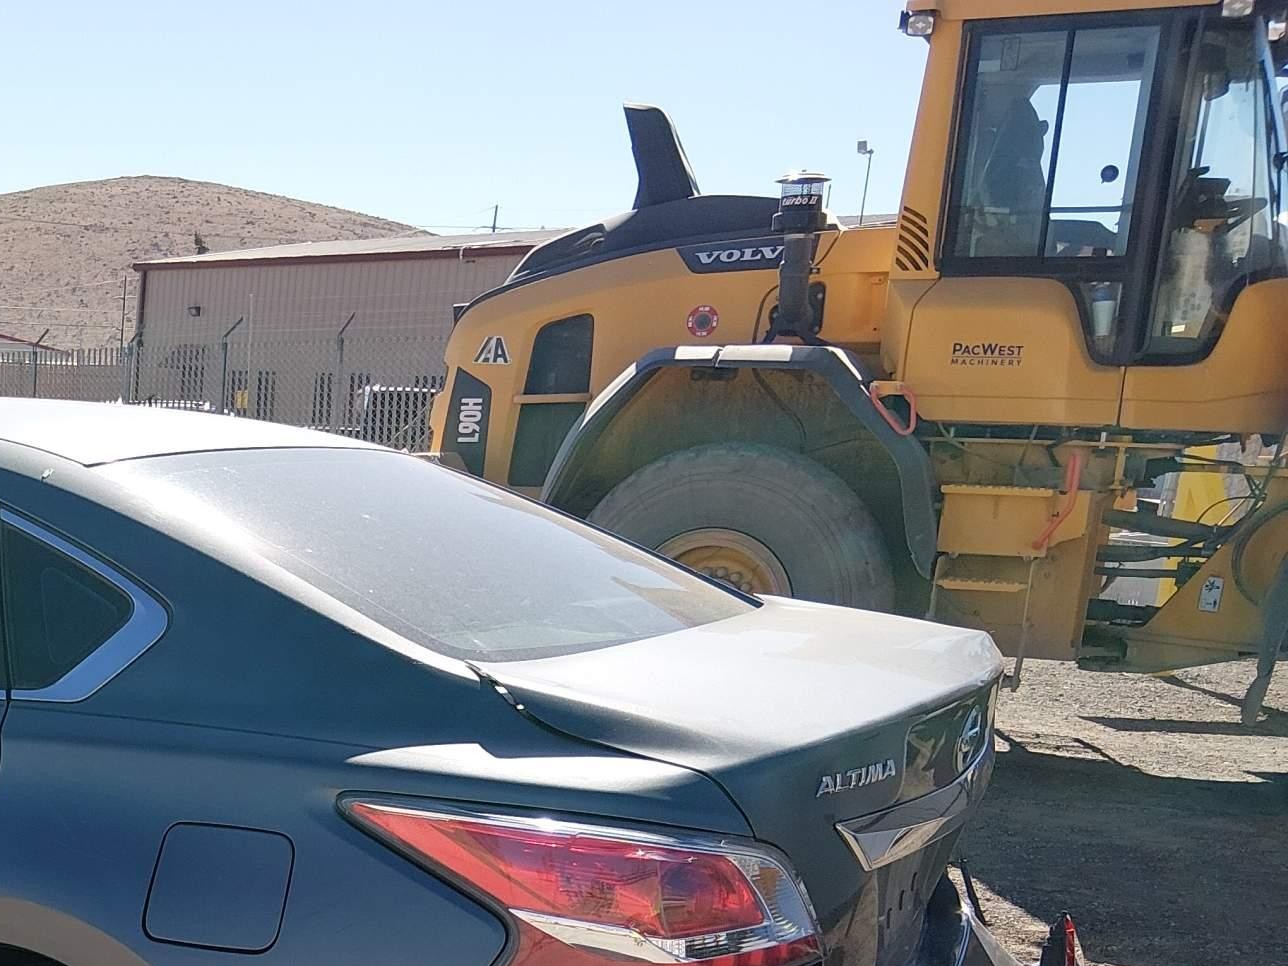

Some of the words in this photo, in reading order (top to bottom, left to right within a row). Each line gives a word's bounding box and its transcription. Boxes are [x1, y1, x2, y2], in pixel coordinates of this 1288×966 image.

[695, 245, 785, 264] VOLV
[951, 358, 1022, 366] MACHINERY
[457, 397, 483, 443] L90H
[815, 759, 896, 798] ALTIMA
